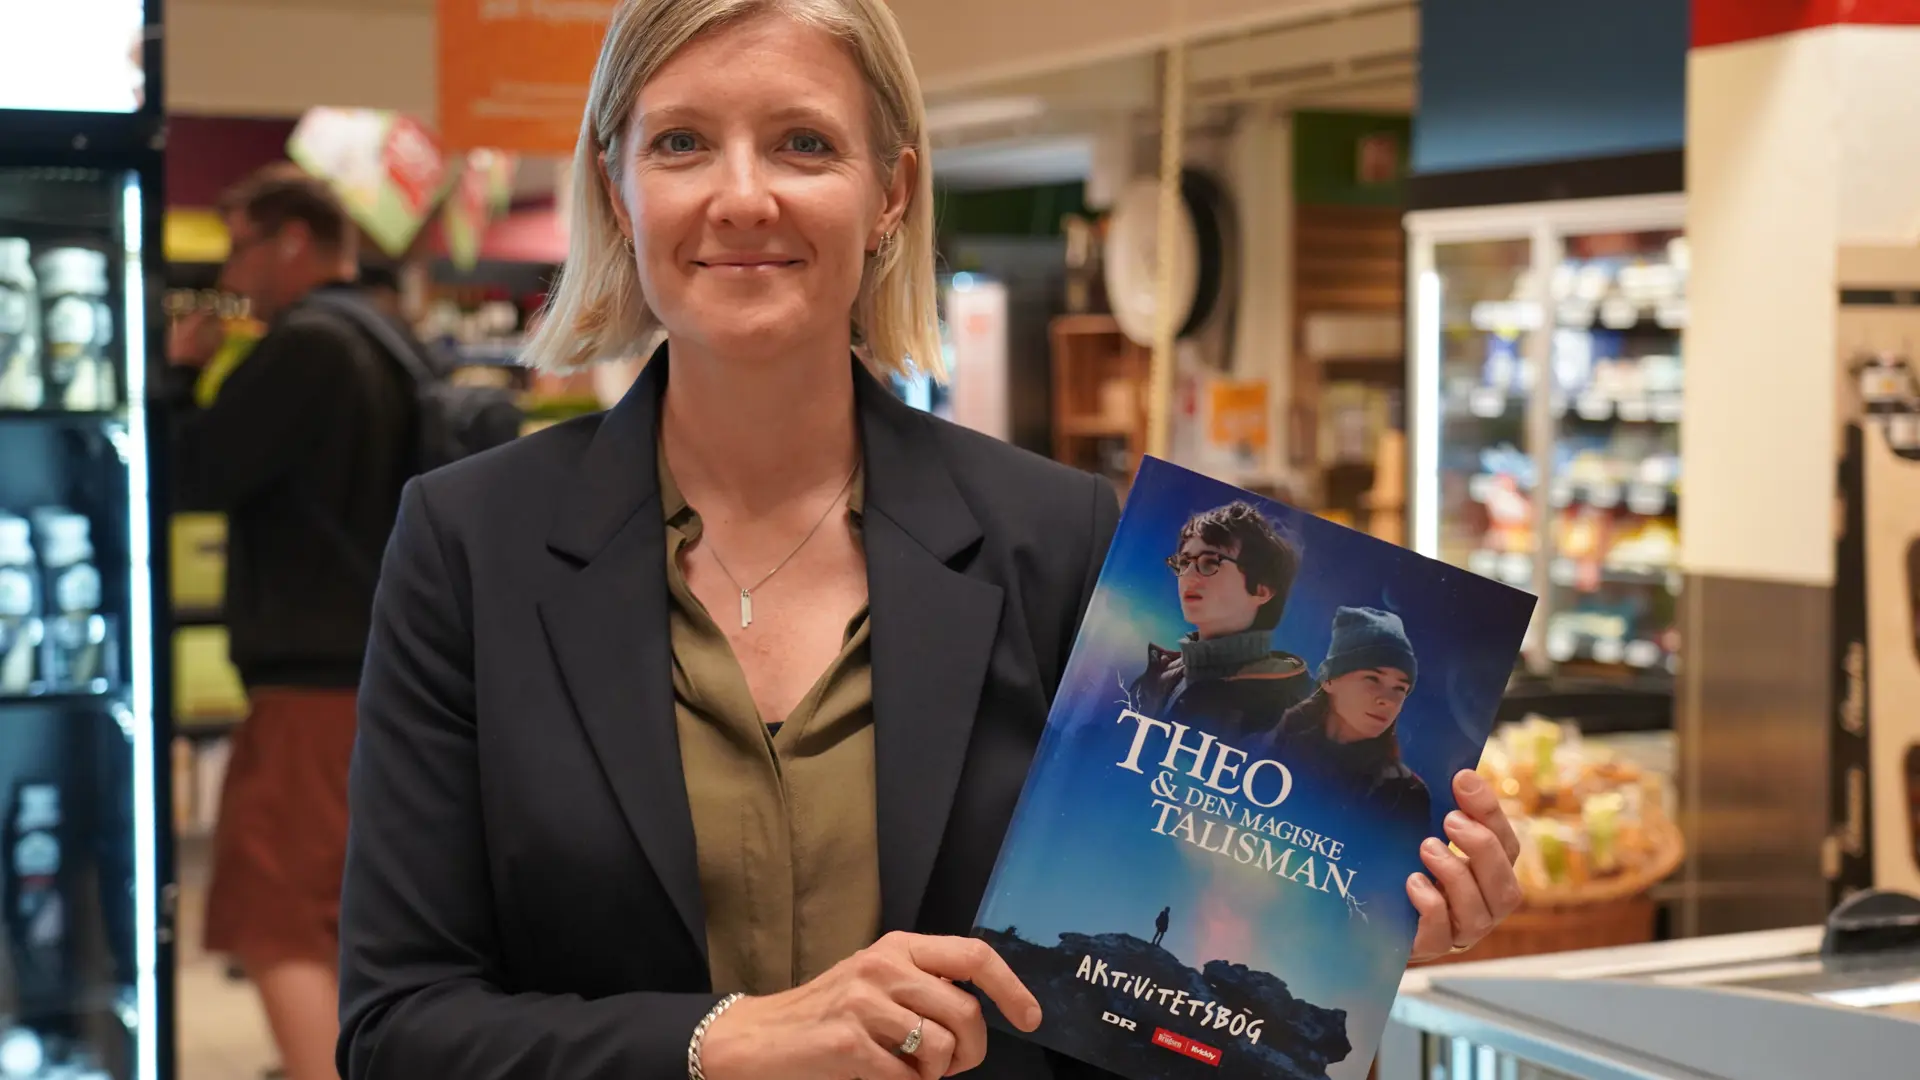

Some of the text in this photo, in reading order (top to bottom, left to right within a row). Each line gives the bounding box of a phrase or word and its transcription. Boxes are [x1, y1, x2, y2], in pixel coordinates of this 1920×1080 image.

[1116, 708, 1293, 808] THEO
[1150, 771, 1345, 861] & DEN MAGISKE
[1150, 800, 1358, 898] TALISMAN
[1101, 1011, 1137, 1031] DR
